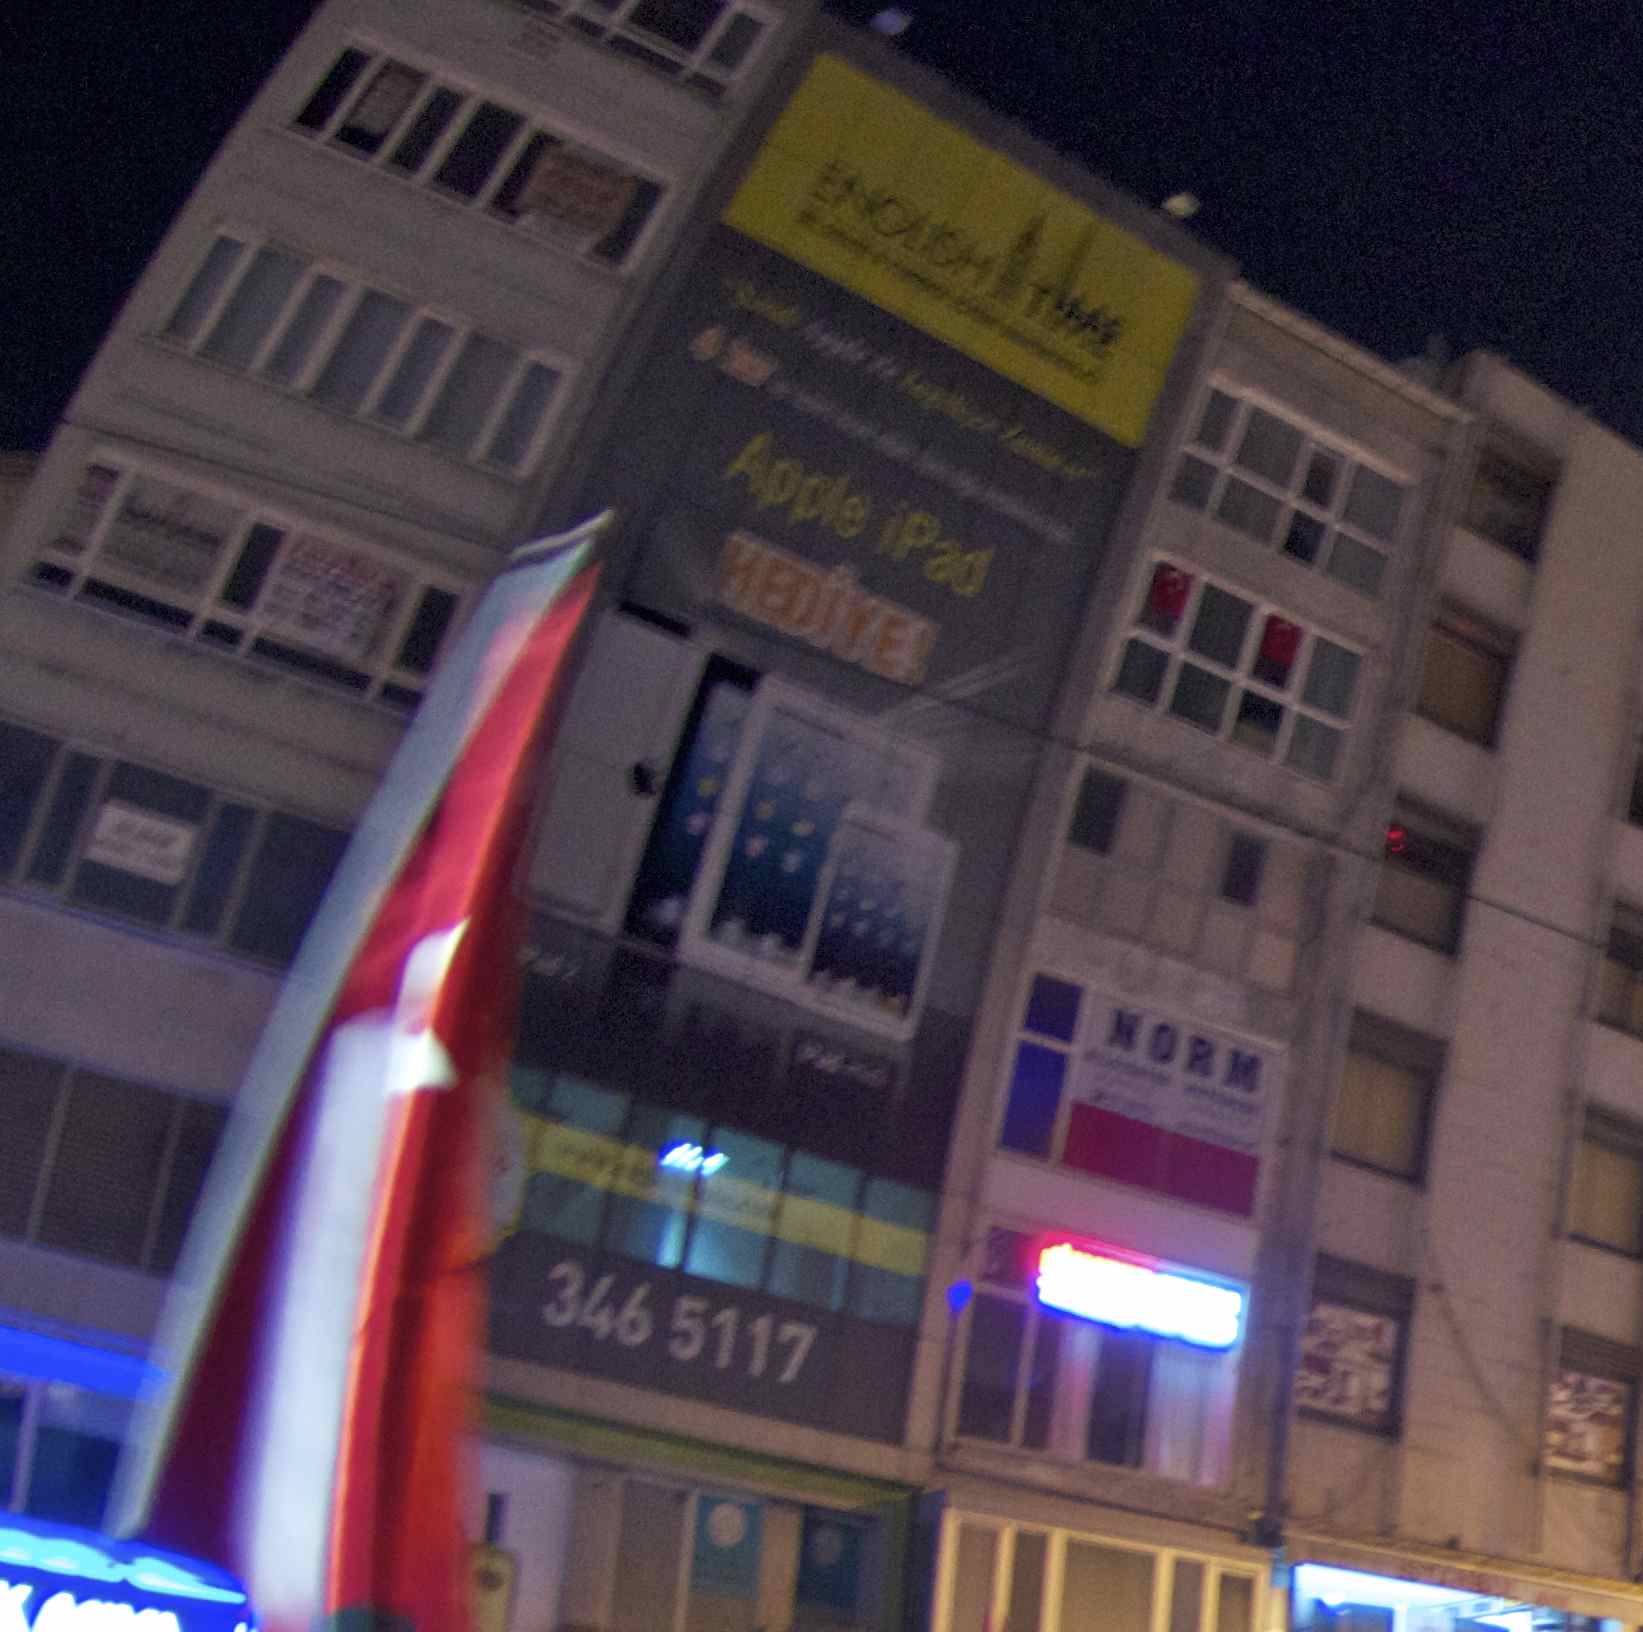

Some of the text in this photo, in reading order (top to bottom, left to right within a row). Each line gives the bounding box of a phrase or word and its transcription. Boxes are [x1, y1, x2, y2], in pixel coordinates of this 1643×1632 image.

[723, 433, 868, 542] Apple
[878, 502, 994, 598] iPad
[1109, 1008, 1262, 1093] NORM
[541, 1259, 818, 1384] 346 5117
